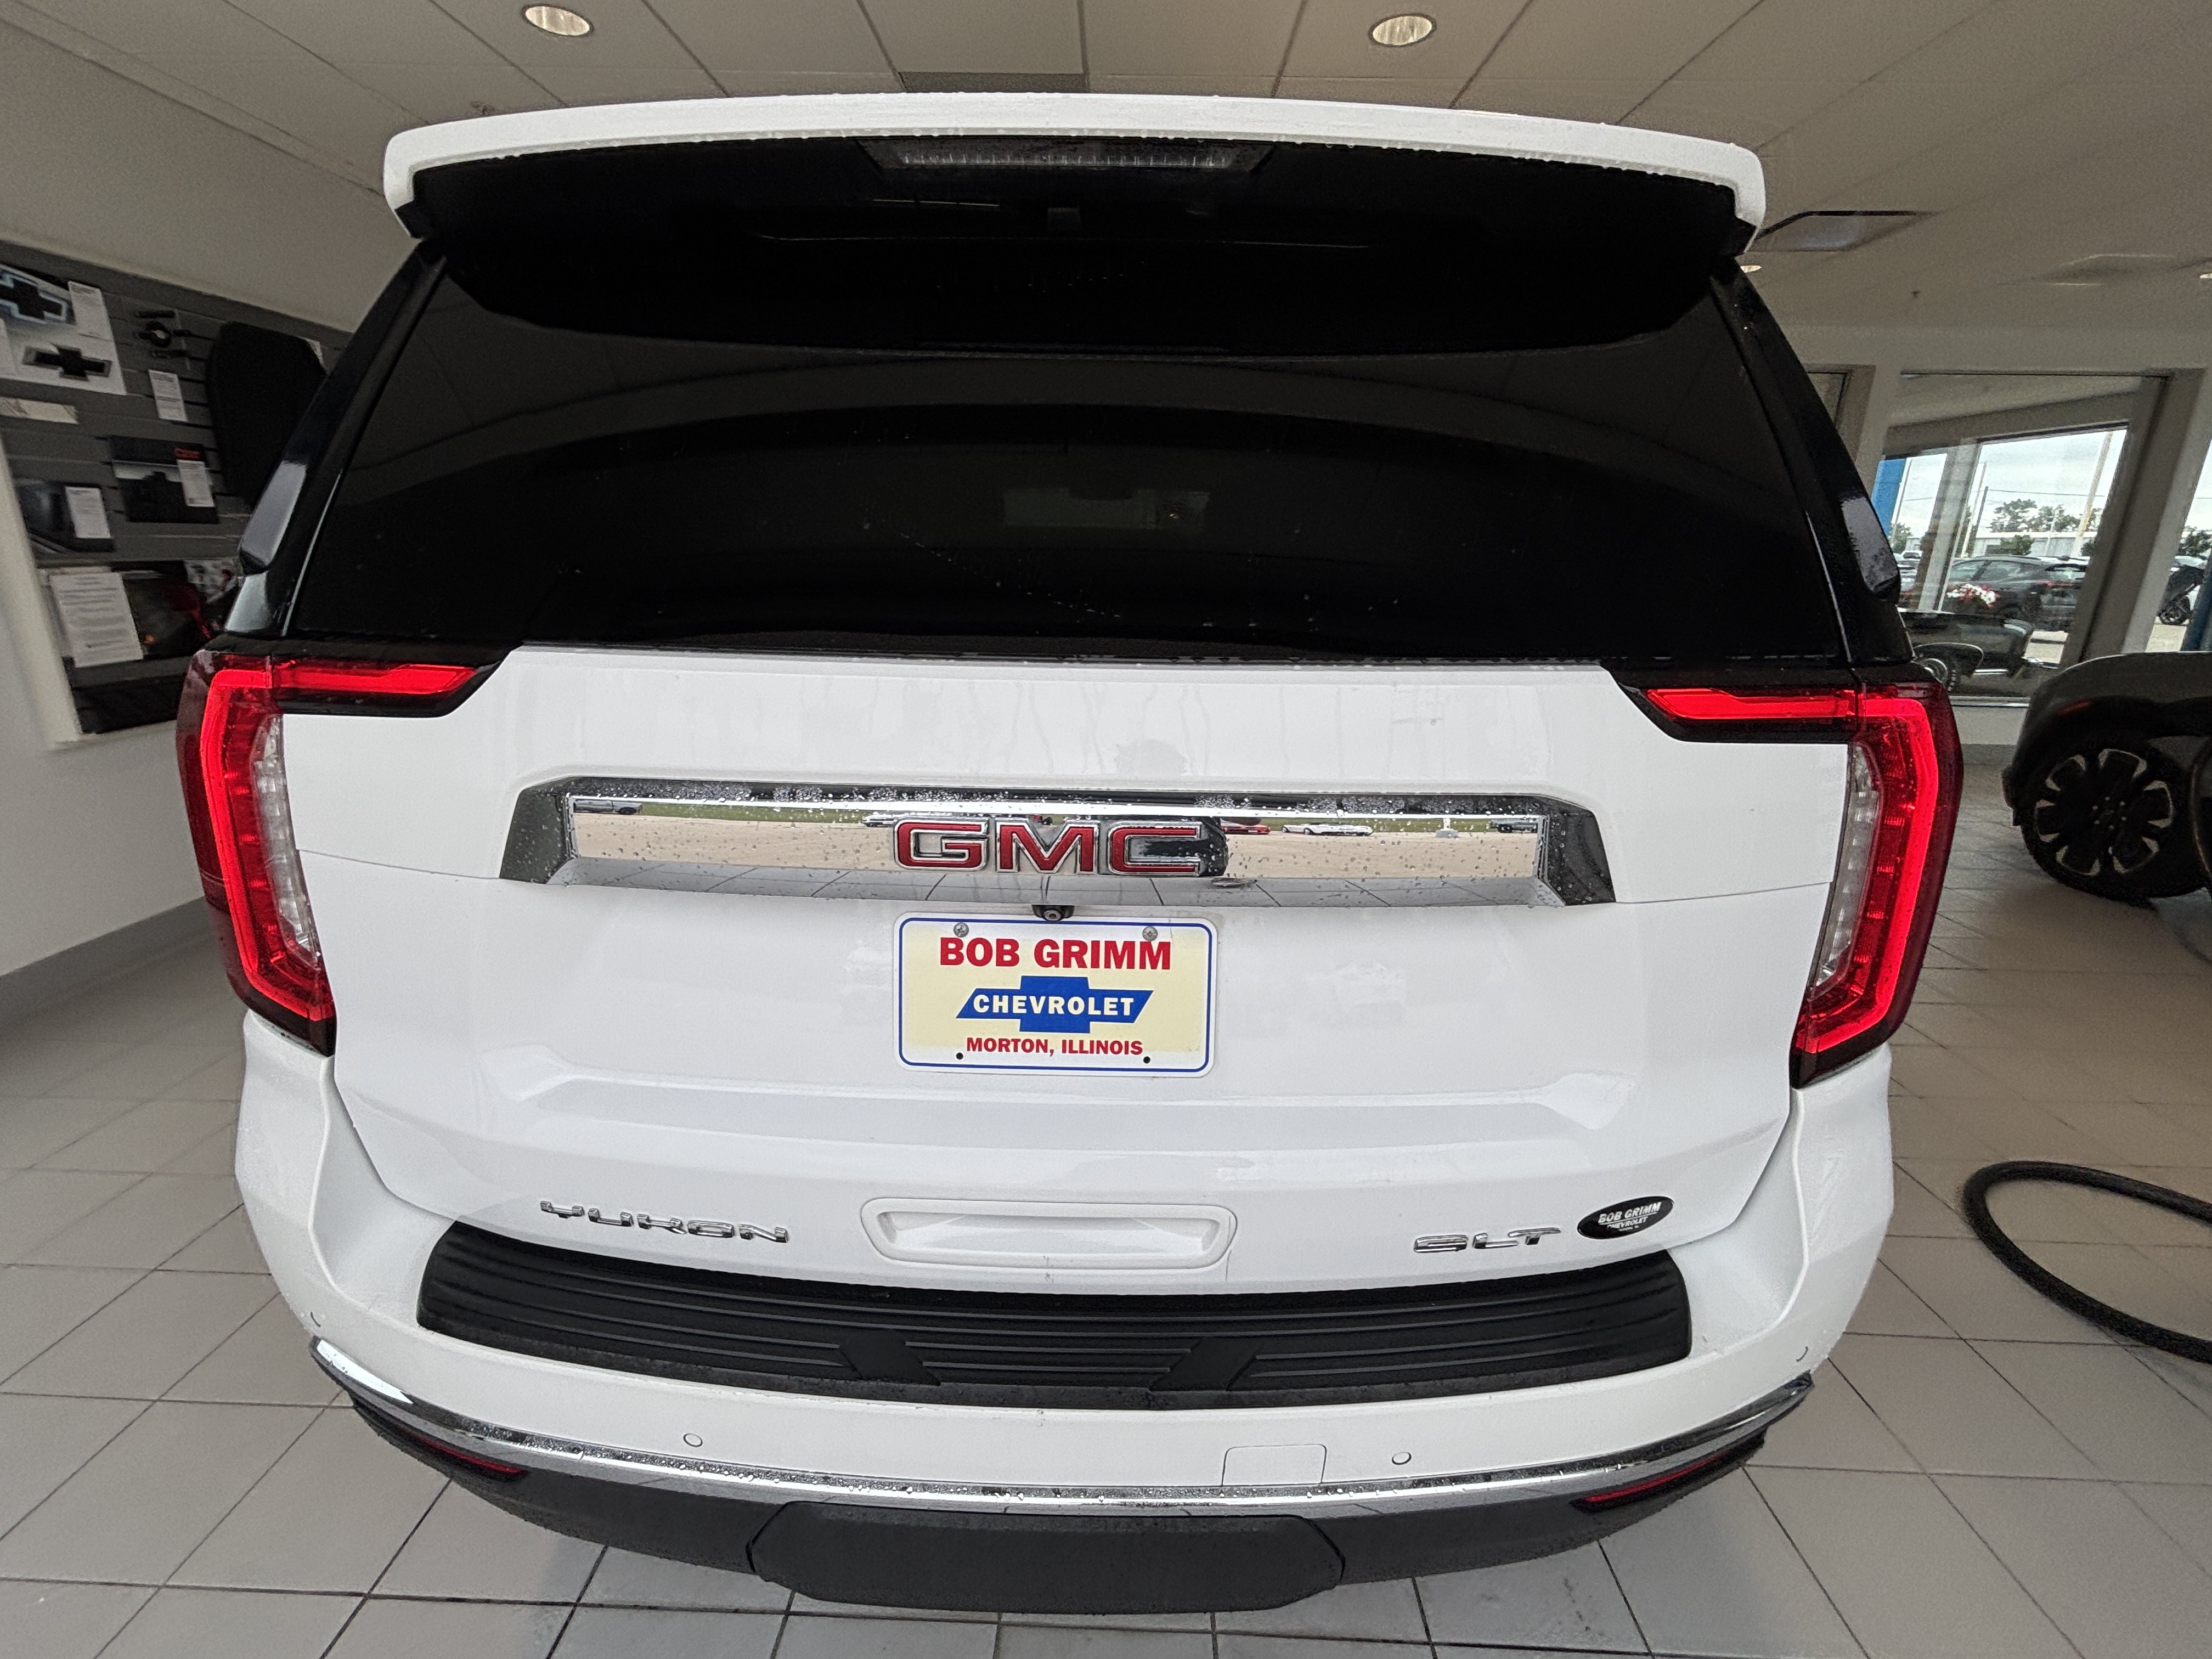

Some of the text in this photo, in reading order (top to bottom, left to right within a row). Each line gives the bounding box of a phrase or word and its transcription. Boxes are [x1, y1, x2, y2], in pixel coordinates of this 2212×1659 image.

[895, 818, 1203, 876] GMC
[940, 937, 1171, 970] BOB GRIMM
[973, 994, 1135, 1016] CHEVROLET
[966, 1037, 1143, 1057] MORTON, ILLINOIS
[540, 1200, 790, 1243] YUKON
[1598, 1201, 1662, 1223] BOB GRIMM
[1606, 1216, 1648, 1229] CHEVROLET
[1413, 1227, 1561, 1253] SLT
